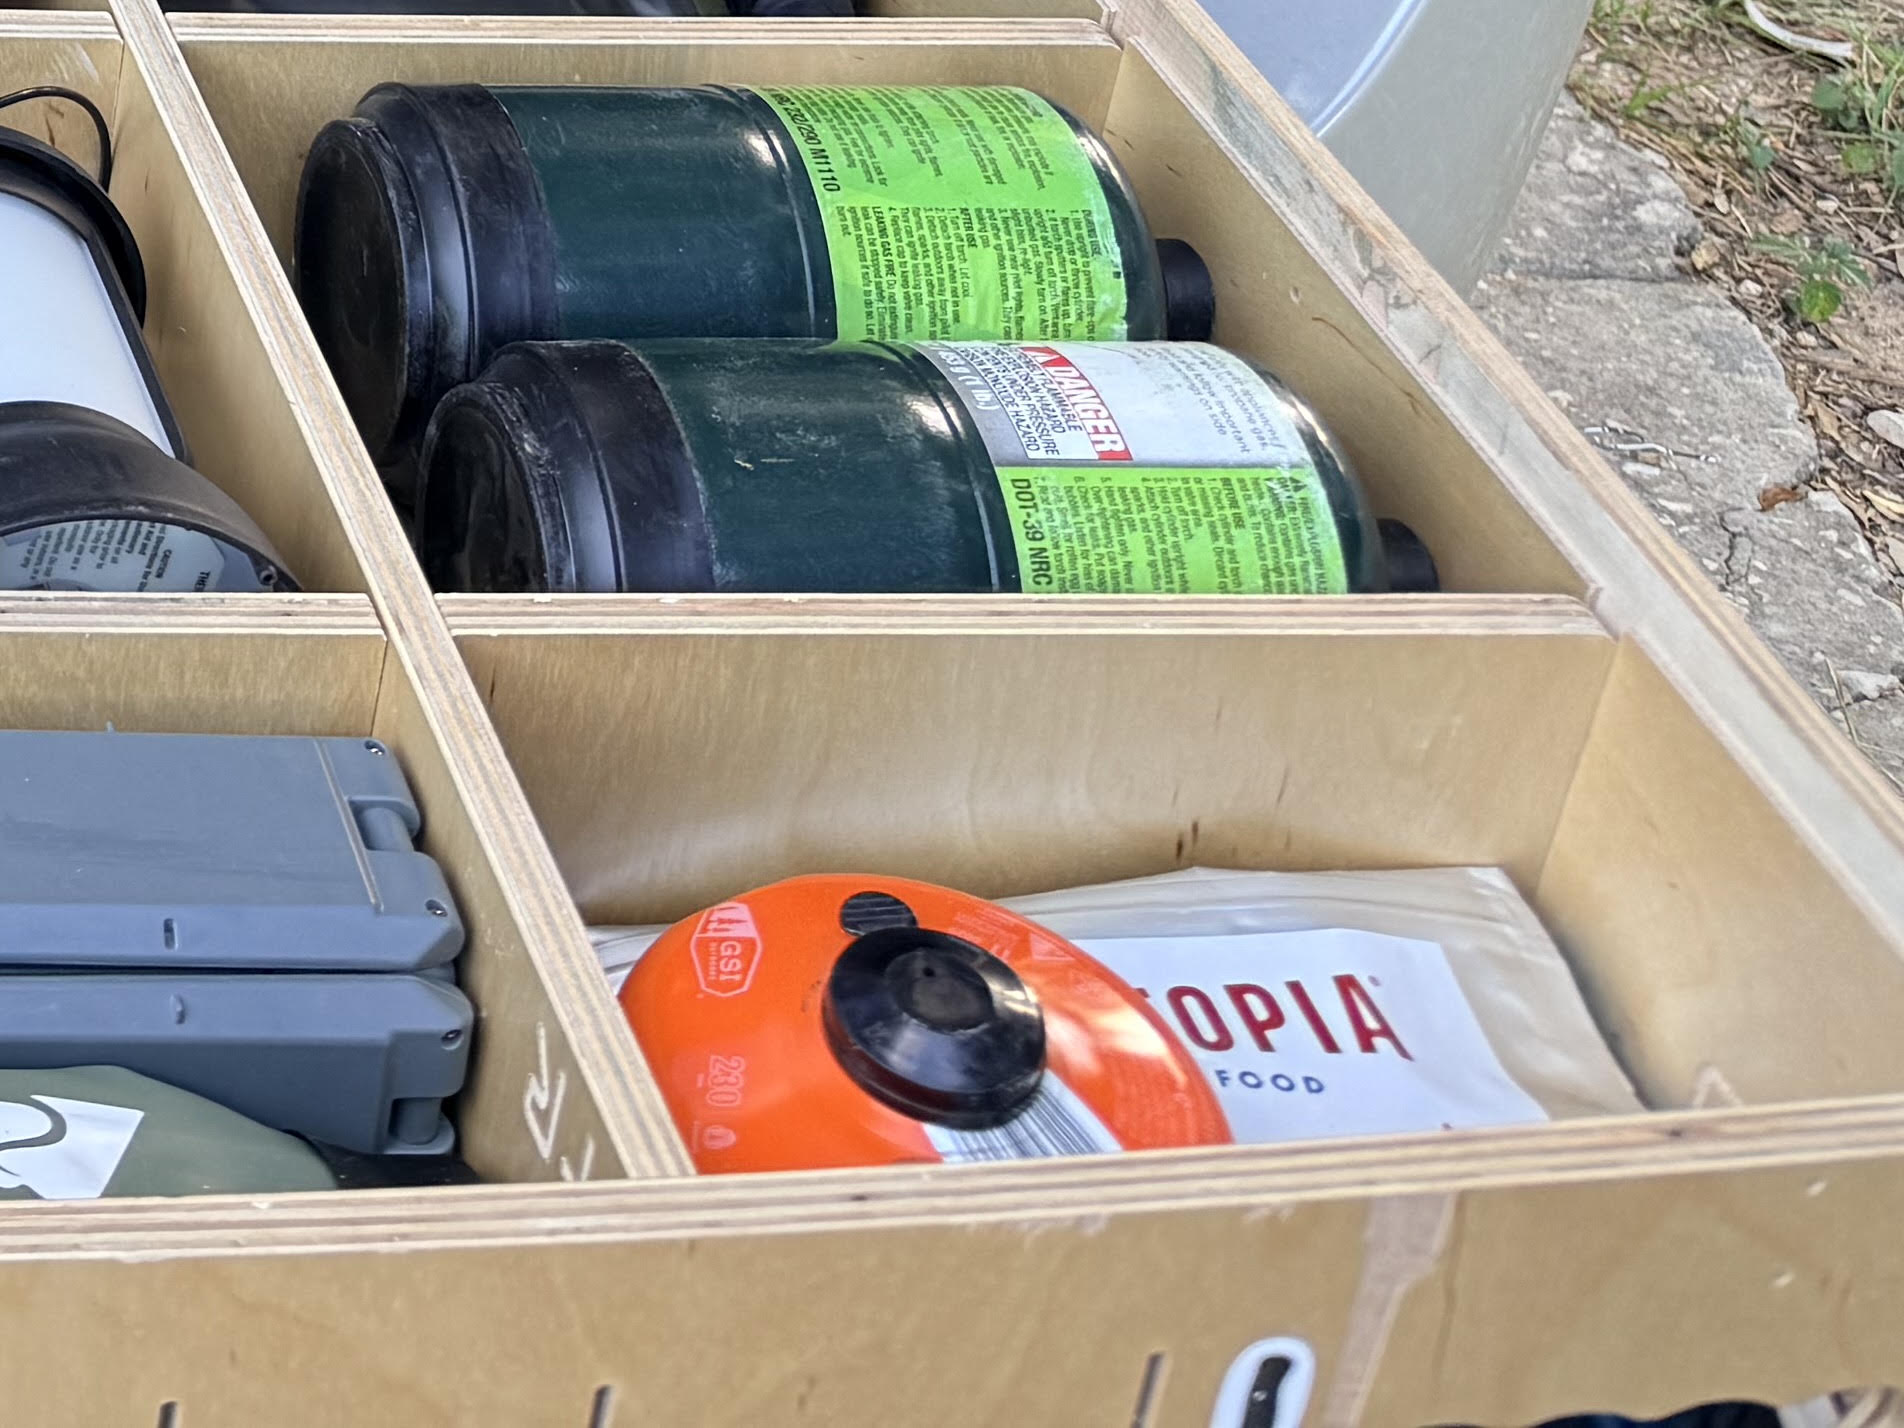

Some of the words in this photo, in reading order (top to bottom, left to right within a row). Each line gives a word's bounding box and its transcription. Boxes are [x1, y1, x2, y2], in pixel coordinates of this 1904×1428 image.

[811, 148, 840, 192] M1110
[1048, 365, 1127, 453] DANGER
[1008, 478, 1045, 545] DOT-39
[1025, 547, 1053, 587] NRC
[718, 935, 744, 989] GSI
[1138, 971, 1416, 1062] OPIA
[708, 1052, 746, 1108] 230
[1216, 1066, 1327, 1097] FOOD
